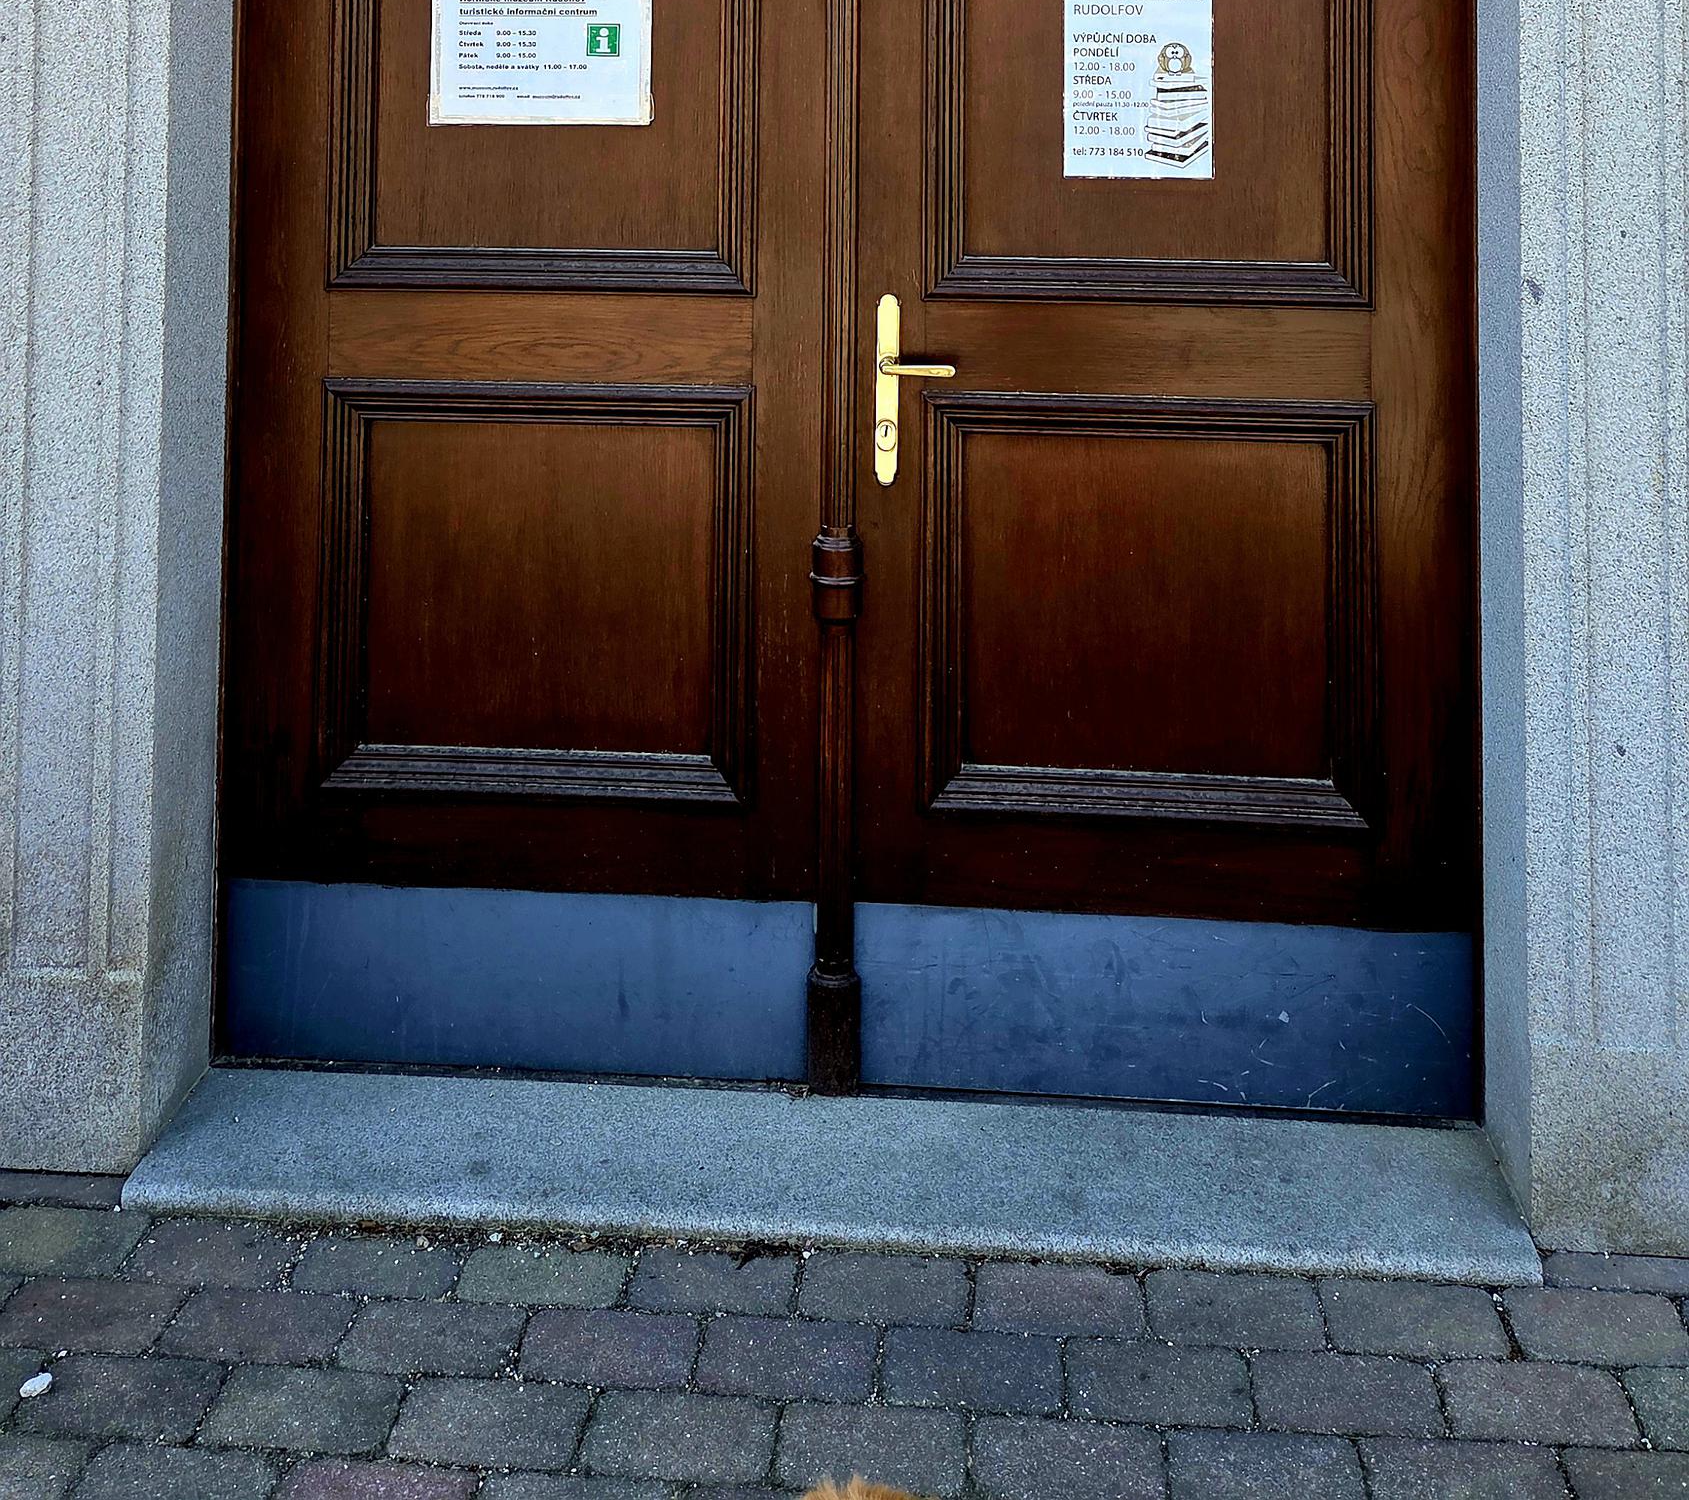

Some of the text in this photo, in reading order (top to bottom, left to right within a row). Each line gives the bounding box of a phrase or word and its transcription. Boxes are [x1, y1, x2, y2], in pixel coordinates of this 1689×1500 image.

[460, 8, 504, 16] turistické
[507, 8, 556, 16] informační
[1073, 5, 1144, 16] RUDOLFOV
[1073, 32, 1156, 44] VÝPŮJČNÍ DOBA
[1074, 46, 1119, 57] PONDĚLÍ
[1074, 62, 1100, 71] 12.00
[1109, 62, 1135, 71] 18.00
[1073, 75, 1112, 85] STŘEDA
[1073, 90, 1094, 99] 9.00
[1106, 90, 1131, 99] 15.00
[1073, 110, 1118, 121] ČTVRTEK
[1074, 126, 1100, 135] 12.00
[1109, 126, 1135, 135] 18.00
[1073, 147, 1144, 156] tel: 773 184 510
